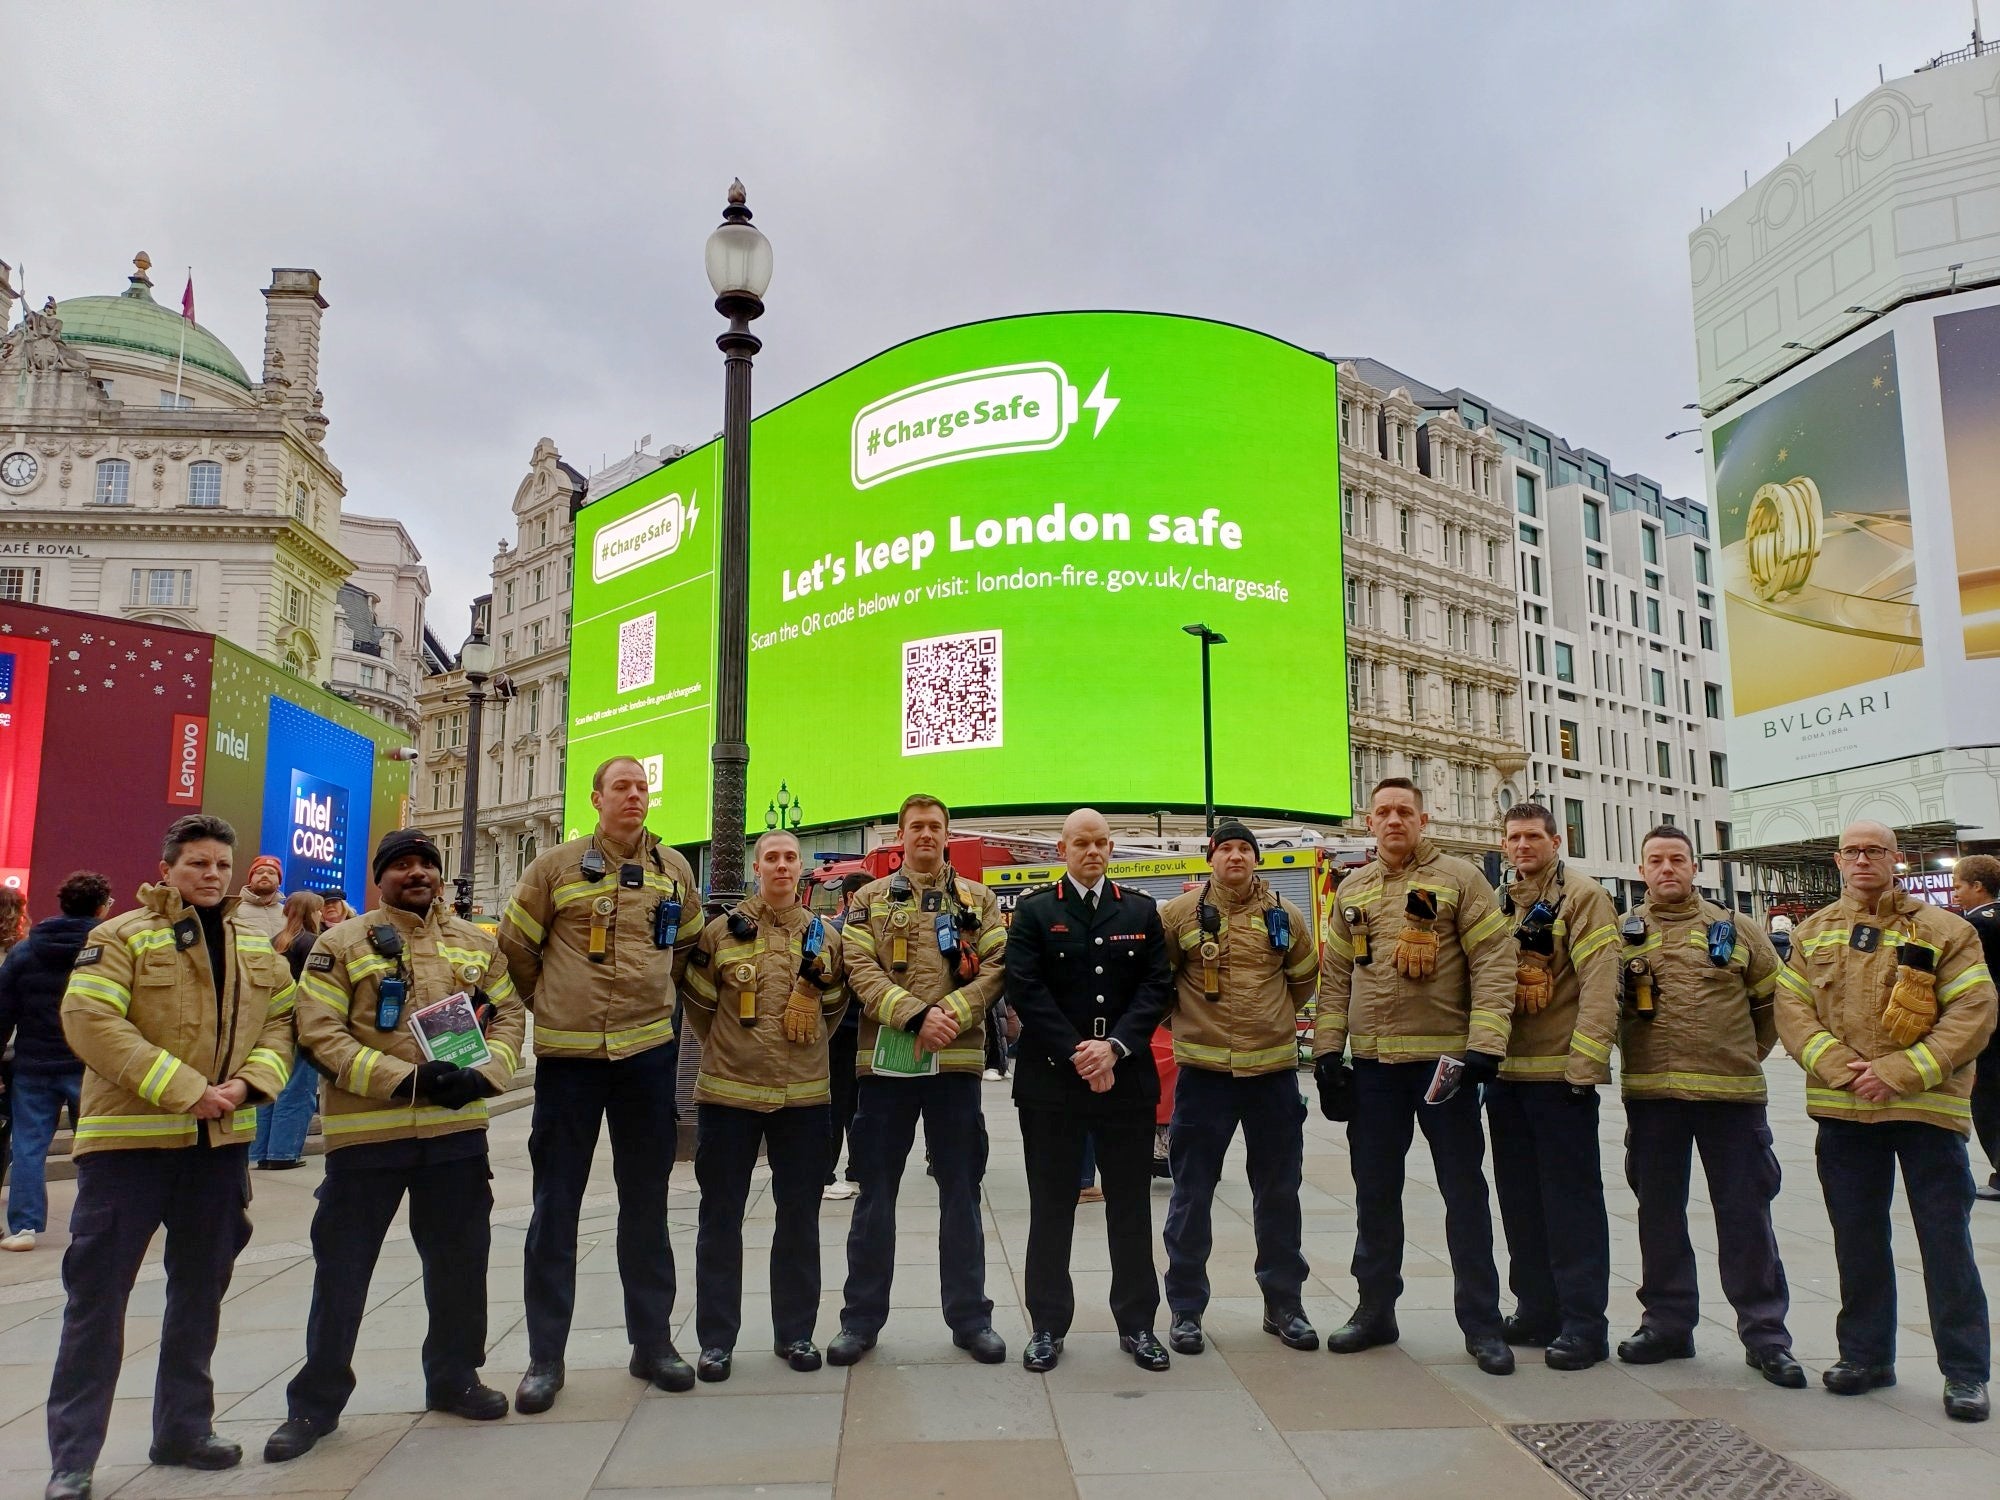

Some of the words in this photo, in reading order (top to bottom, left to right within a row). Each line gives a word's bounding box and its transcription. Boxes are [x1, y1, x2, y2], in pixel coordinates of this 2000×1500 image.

[867, 394, 1041, 456] #ChargeSafe
[0, 541, 30, 555] AFÉ
[37, 545, 84, 556] ROYAL
[601, 518, 672, 562] #ChargeSafe
[782, 553, 845, 602] Let's
[855, 530, 935, 571] keep
[949, 502, 1131, 552] London
[1148, 507, 1243, 550] safe
[751, 632, 777, 652] Scan
[779, 622, 799, 643] the
[801, 613, 822, 636] QR
[823, 602, 855, 628] code
[858, 592, 901, 618] below
[904, 586, 922, 605] or
[926, 577, 970, 600] visit:
[976, 566, 1290, 603] london-fire.gov.uk/chargesafe
[1763, 691, 1891, 739] BVLGARI
[176, 723, 199, 798] Lenovo
[295, 786, 332, 832] intel
[1106, 860, 1187, 874] ndon-fire.gov.uk
